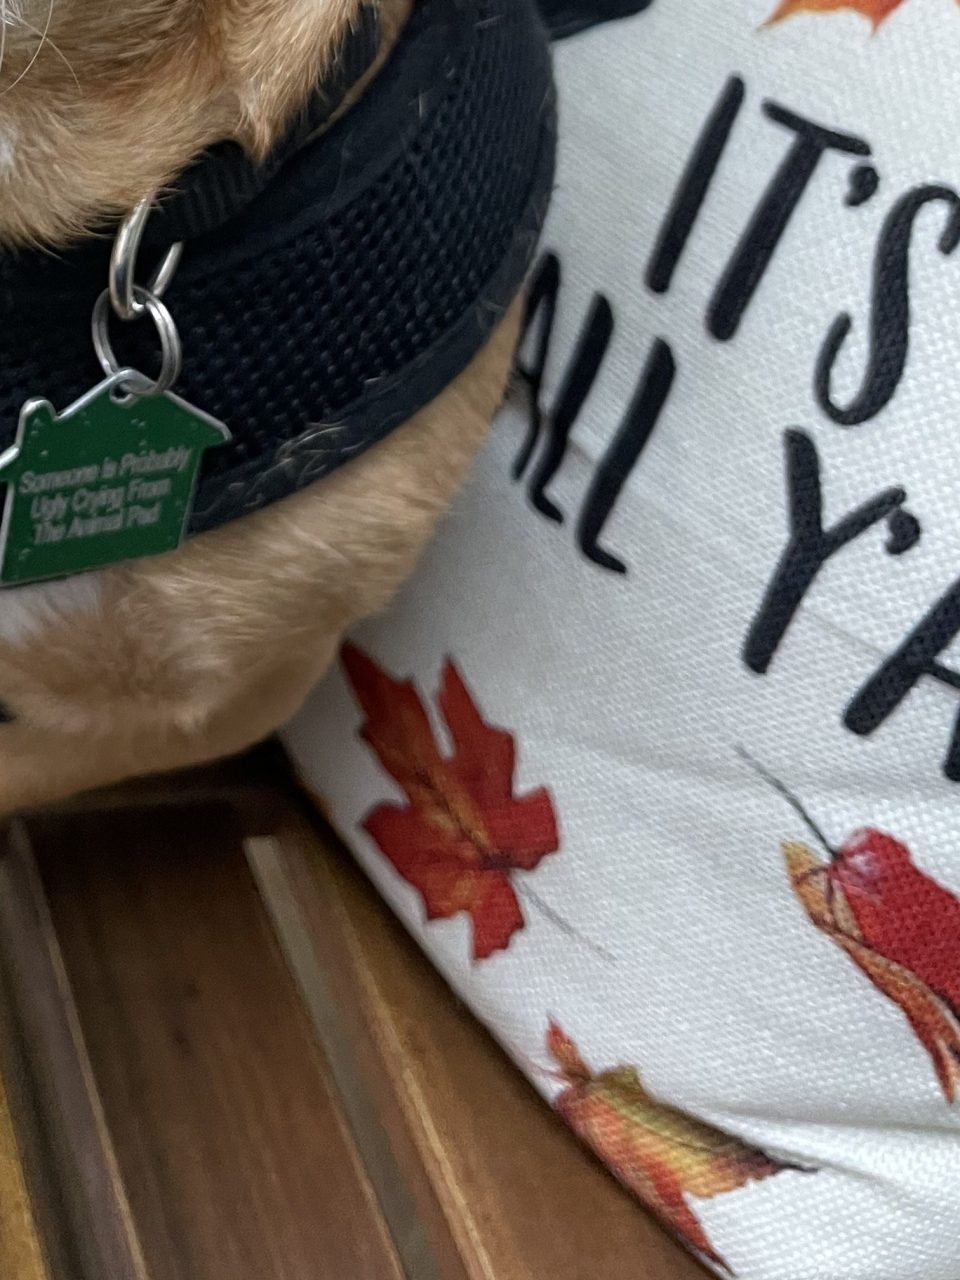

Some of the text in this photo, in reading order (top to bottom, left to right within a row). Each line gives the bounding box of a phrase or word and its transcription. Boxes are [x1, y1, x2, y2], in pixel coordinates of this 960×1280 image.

[645, 74, 960, 425] IT'S
[19, 465, 100, 494] Someone
[119, 446, 192, 476] Probably
[127, 478, 171, 502] From
[67, 508, 124, 538] Animal
